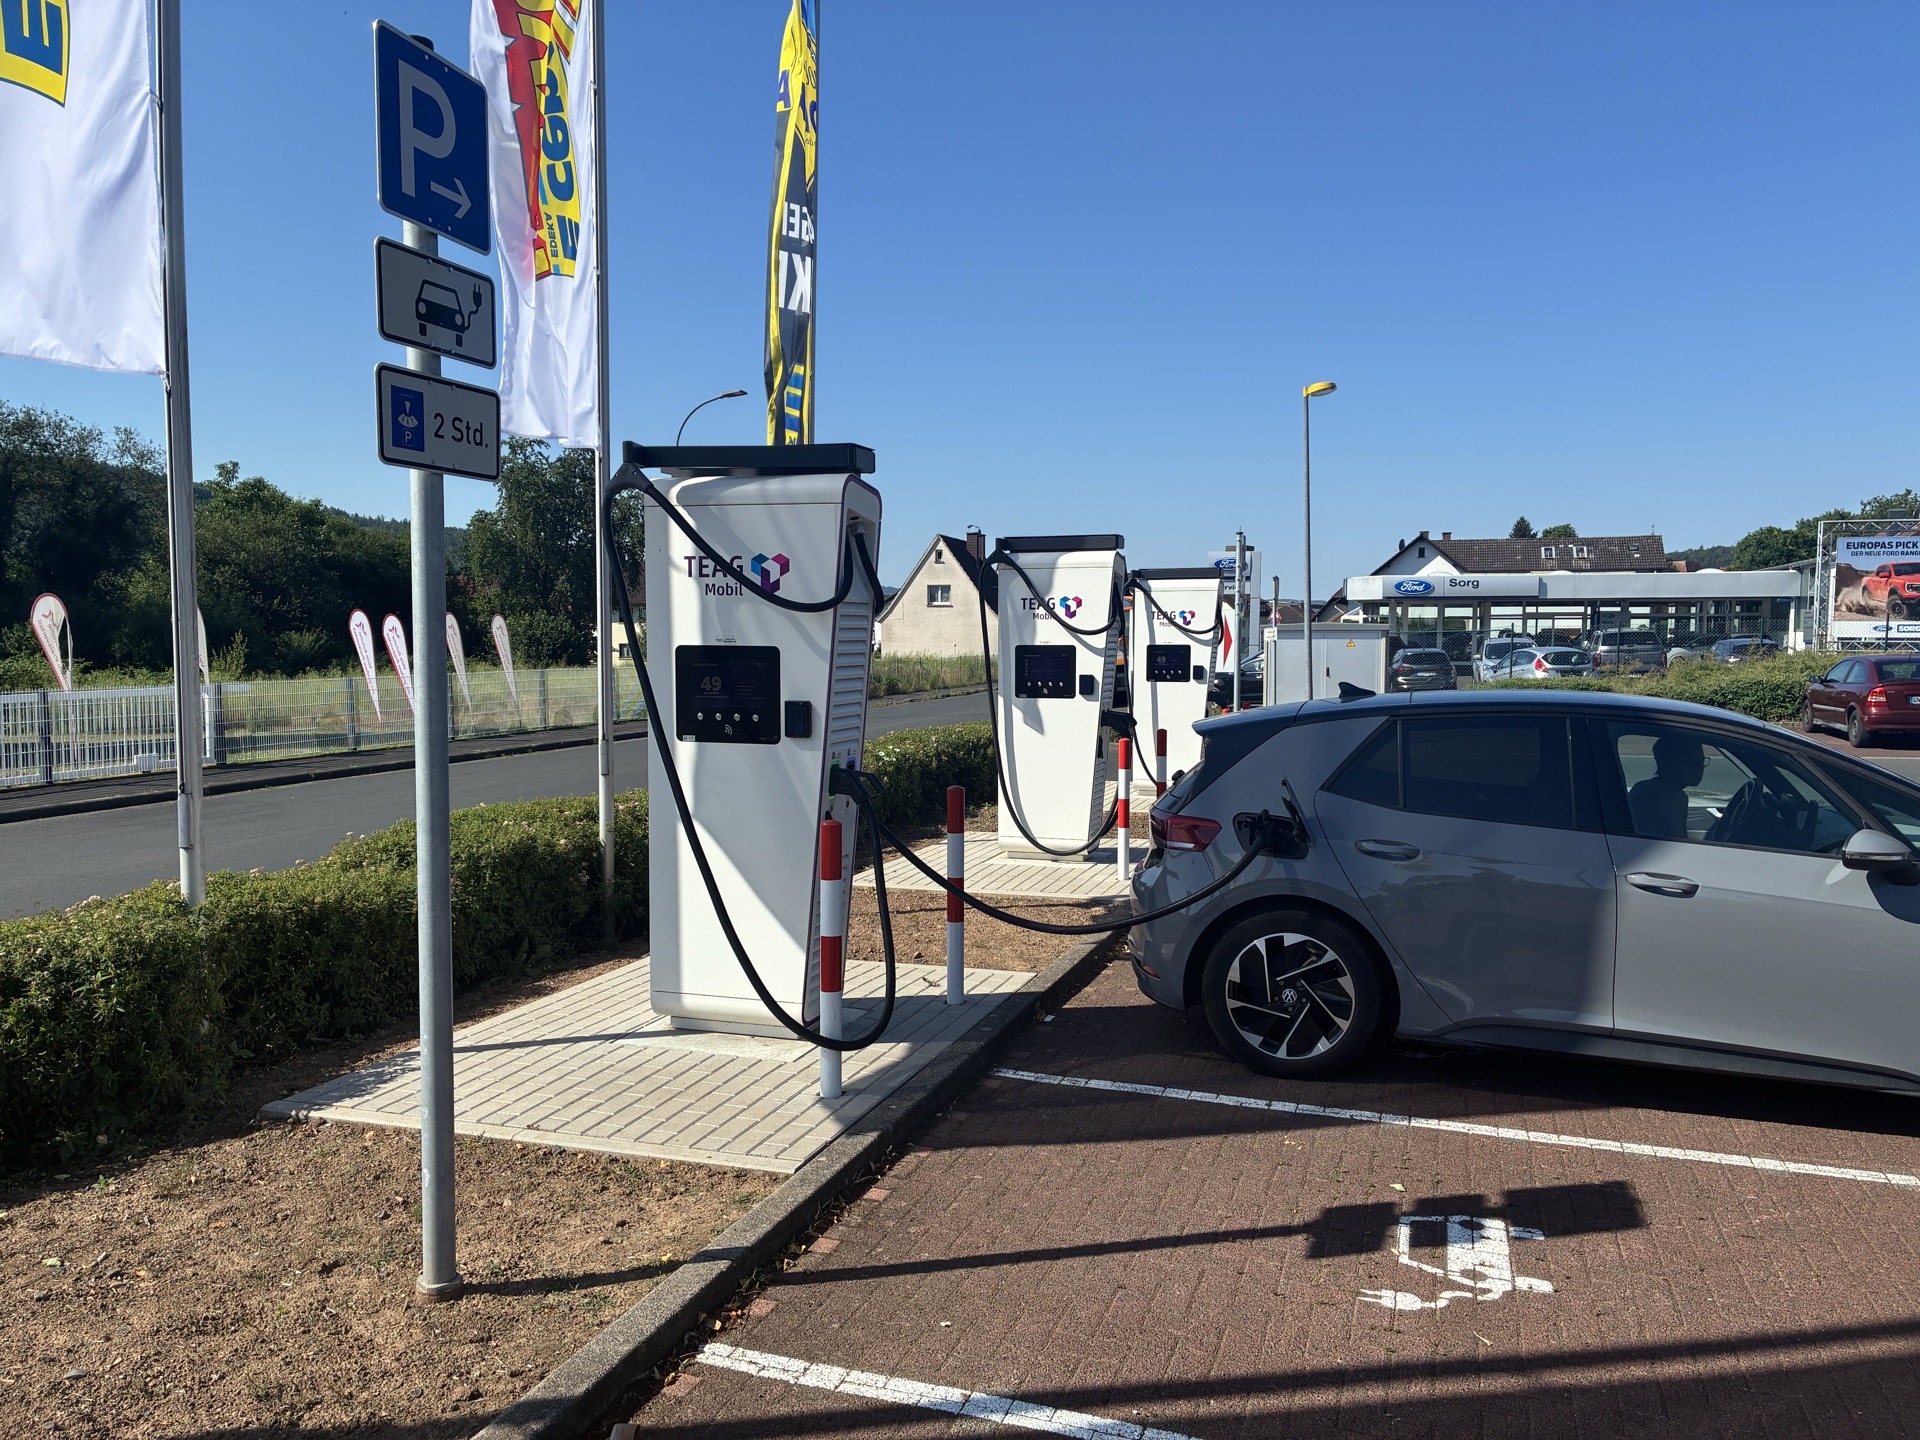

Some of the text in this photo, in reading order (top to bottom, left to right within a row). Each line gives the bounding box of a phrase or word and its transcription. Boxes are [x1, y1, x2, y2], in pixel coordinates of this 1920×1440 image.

[399, 58, 457, 198] P
[433, 412, 489, 449] 2 Std.
[1846, 541, 1894, 550] EUROPAS
[705, 582, 744, 596] Mobil
[1400, 580, 1426, 592] Ford
[1449, 578, 1480, 589] Sorg
[700, 676, 722, 692] 49
